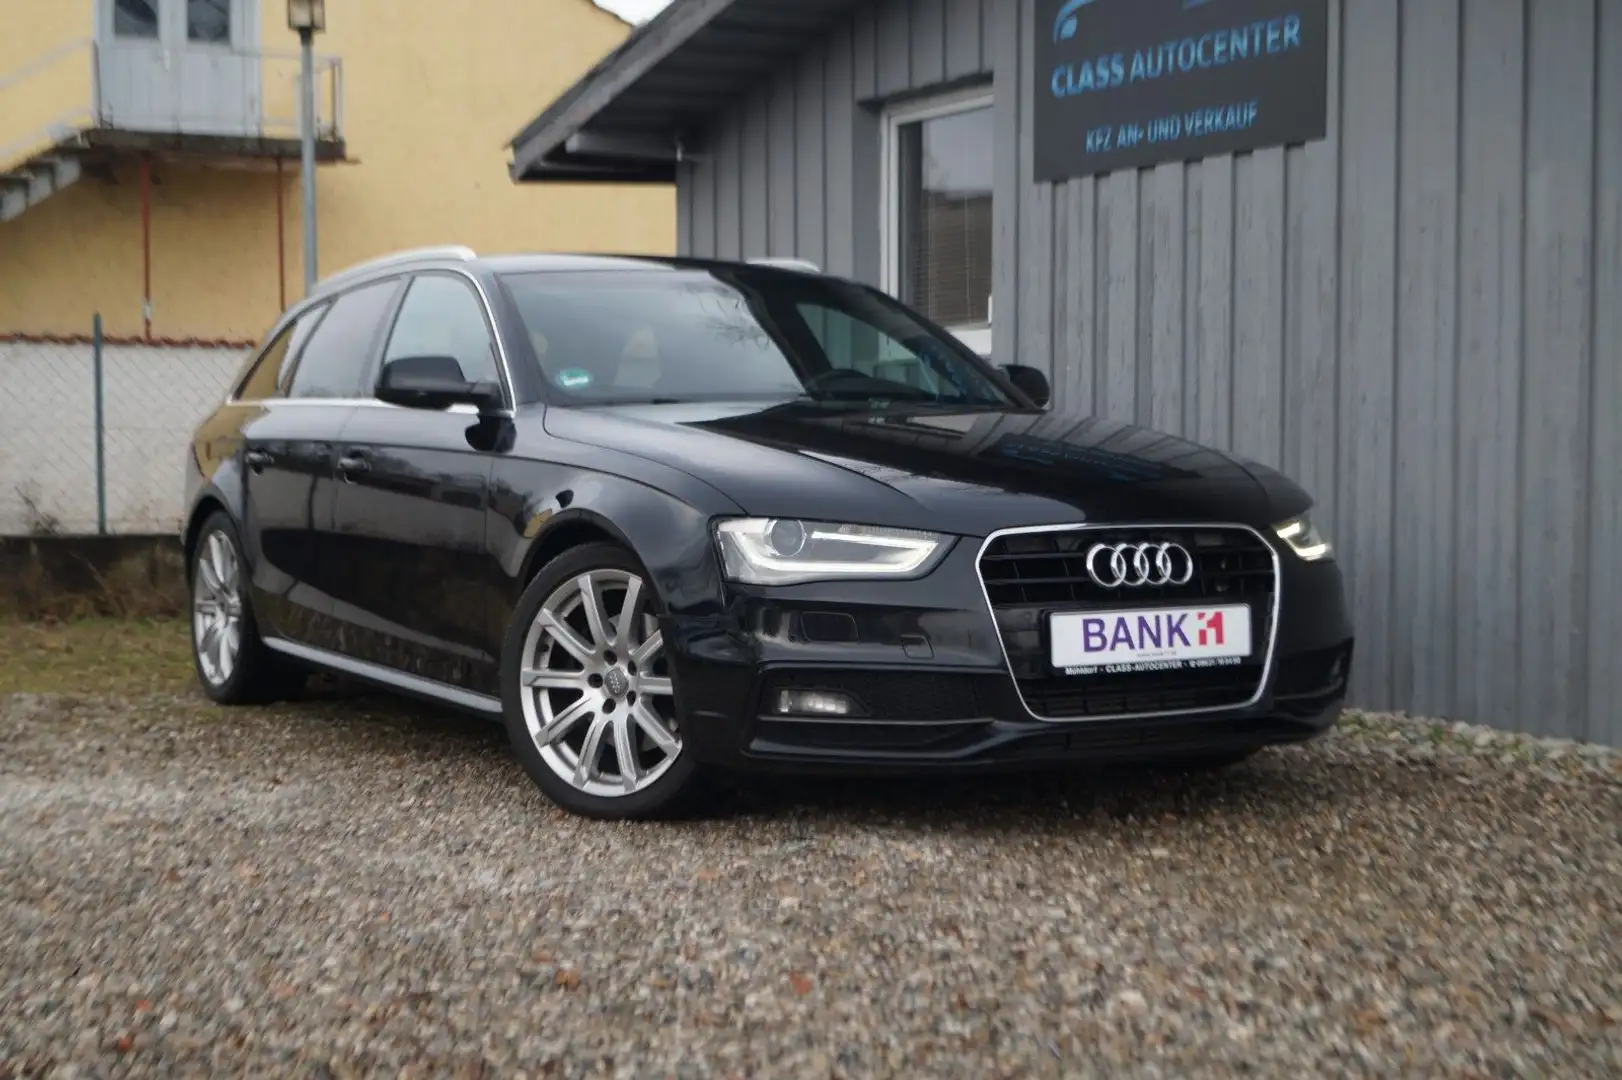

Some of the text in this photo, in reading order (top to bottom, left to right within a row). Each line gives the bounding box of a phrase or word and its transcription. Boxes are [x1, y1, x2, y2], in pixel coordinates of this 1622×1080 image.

[1051, 13, 1301, 98] CLASS AUTOCENTER
[1085, 126, 1113, 153] KFZ
[1147, 115, 1181, 143] UND
[1184, 101, 1258, 136] VERKAUF
